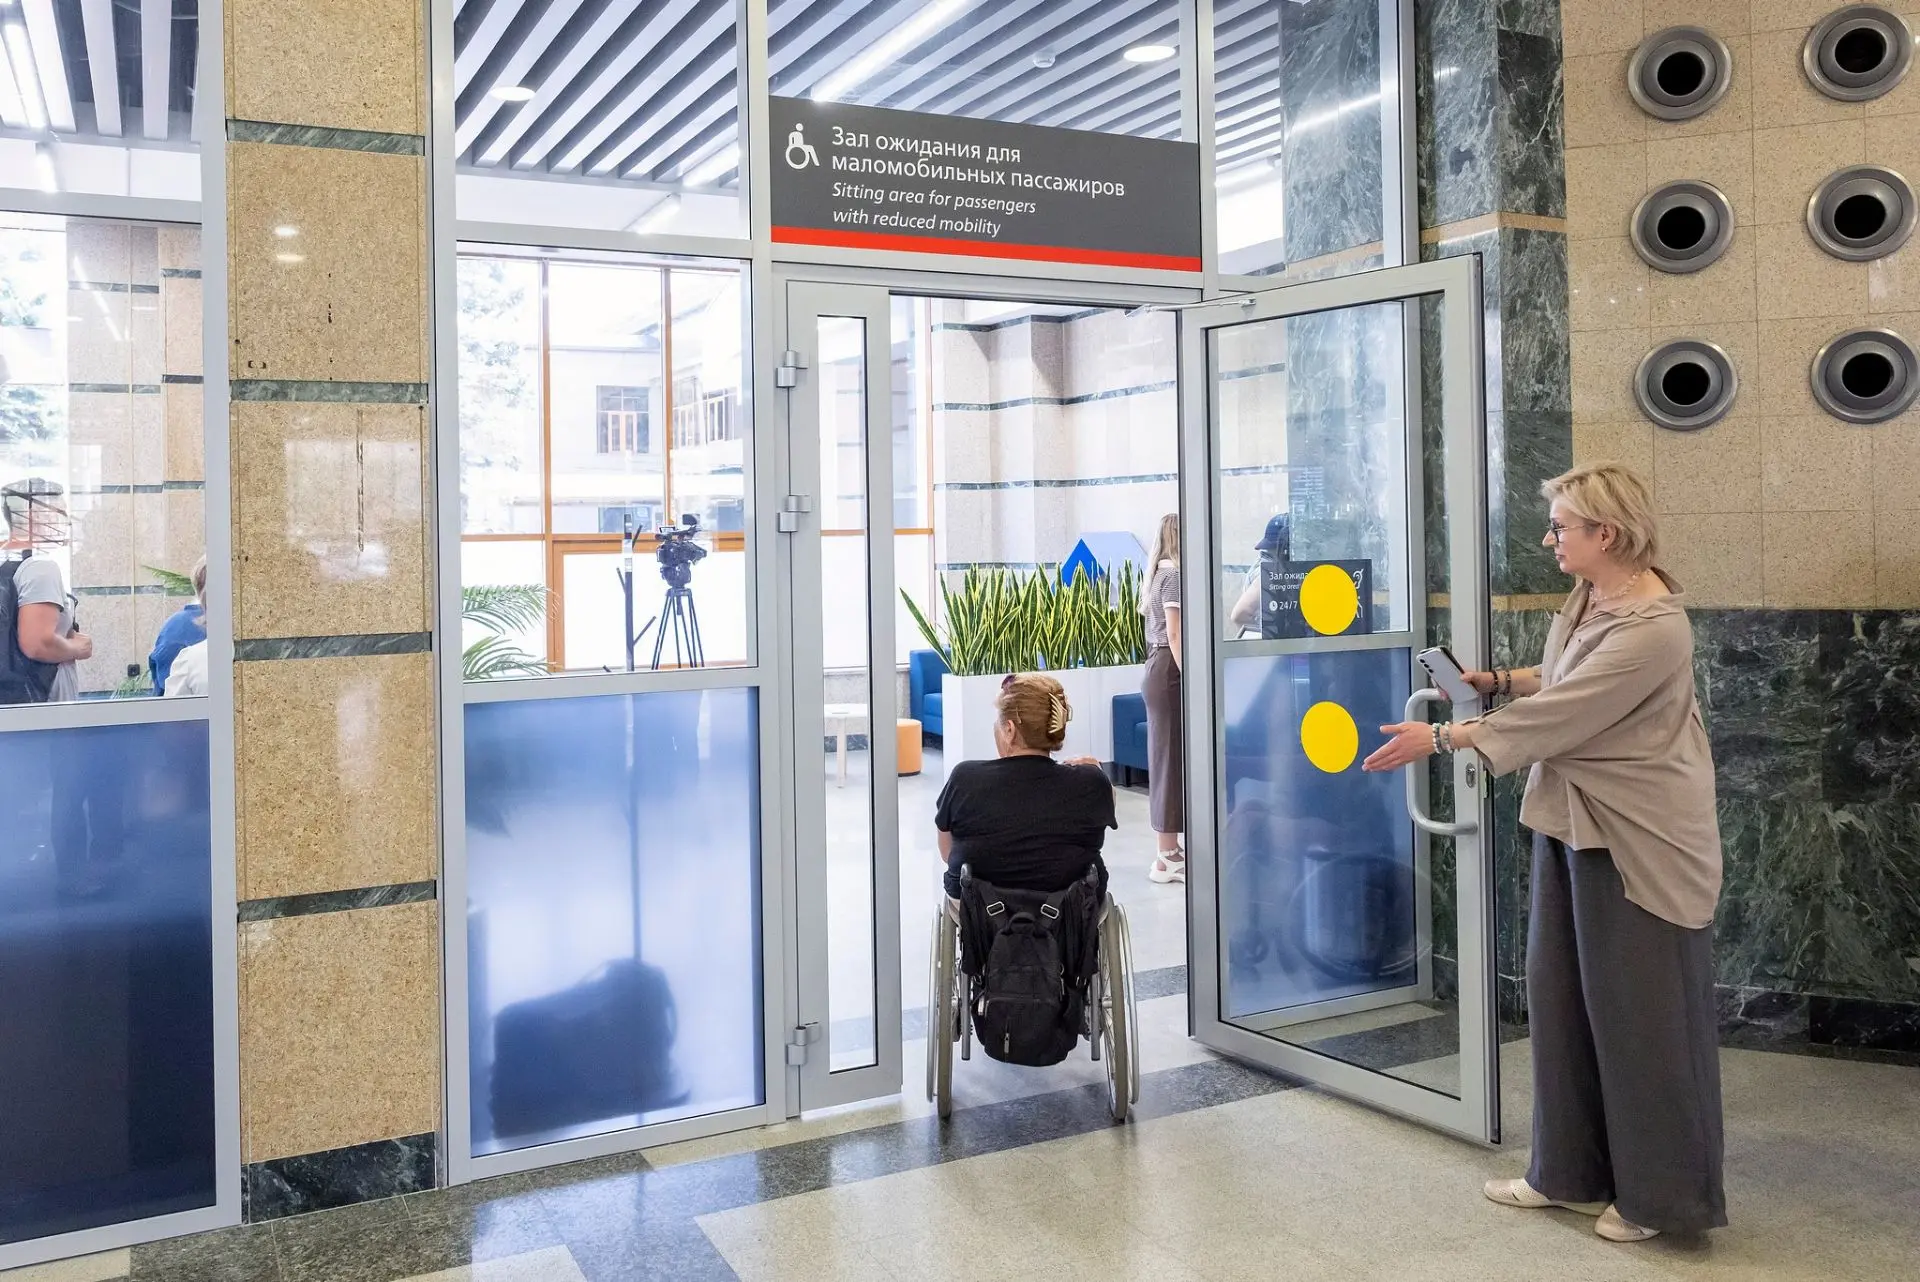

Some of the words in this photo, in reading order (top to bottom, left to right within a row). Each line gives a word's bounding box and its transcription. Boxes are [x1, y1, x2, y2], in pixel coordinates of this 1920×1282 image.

[831, 125, 869, 149] Зал
[875, 135, 981, 160] ожидания
[985, 146, 1021, 165] для
[832, 155, 1006, 187] маломобильных
[1011, 172, 1126, 199] пассажиров
[831, 181, 885, 205] Sitting
[888, 190, 925, 204] area
[928, 189, 953, 206] for
[953, 196, 1037, 216] passengers
[832, 208, 869, 225] with
[872, 211, 937, 230] reduced
[939, 217, 1002, 239] mobility
[1269, 571, 1284, 581] Зал
[1279, 600, 1298, 610] 24/7
